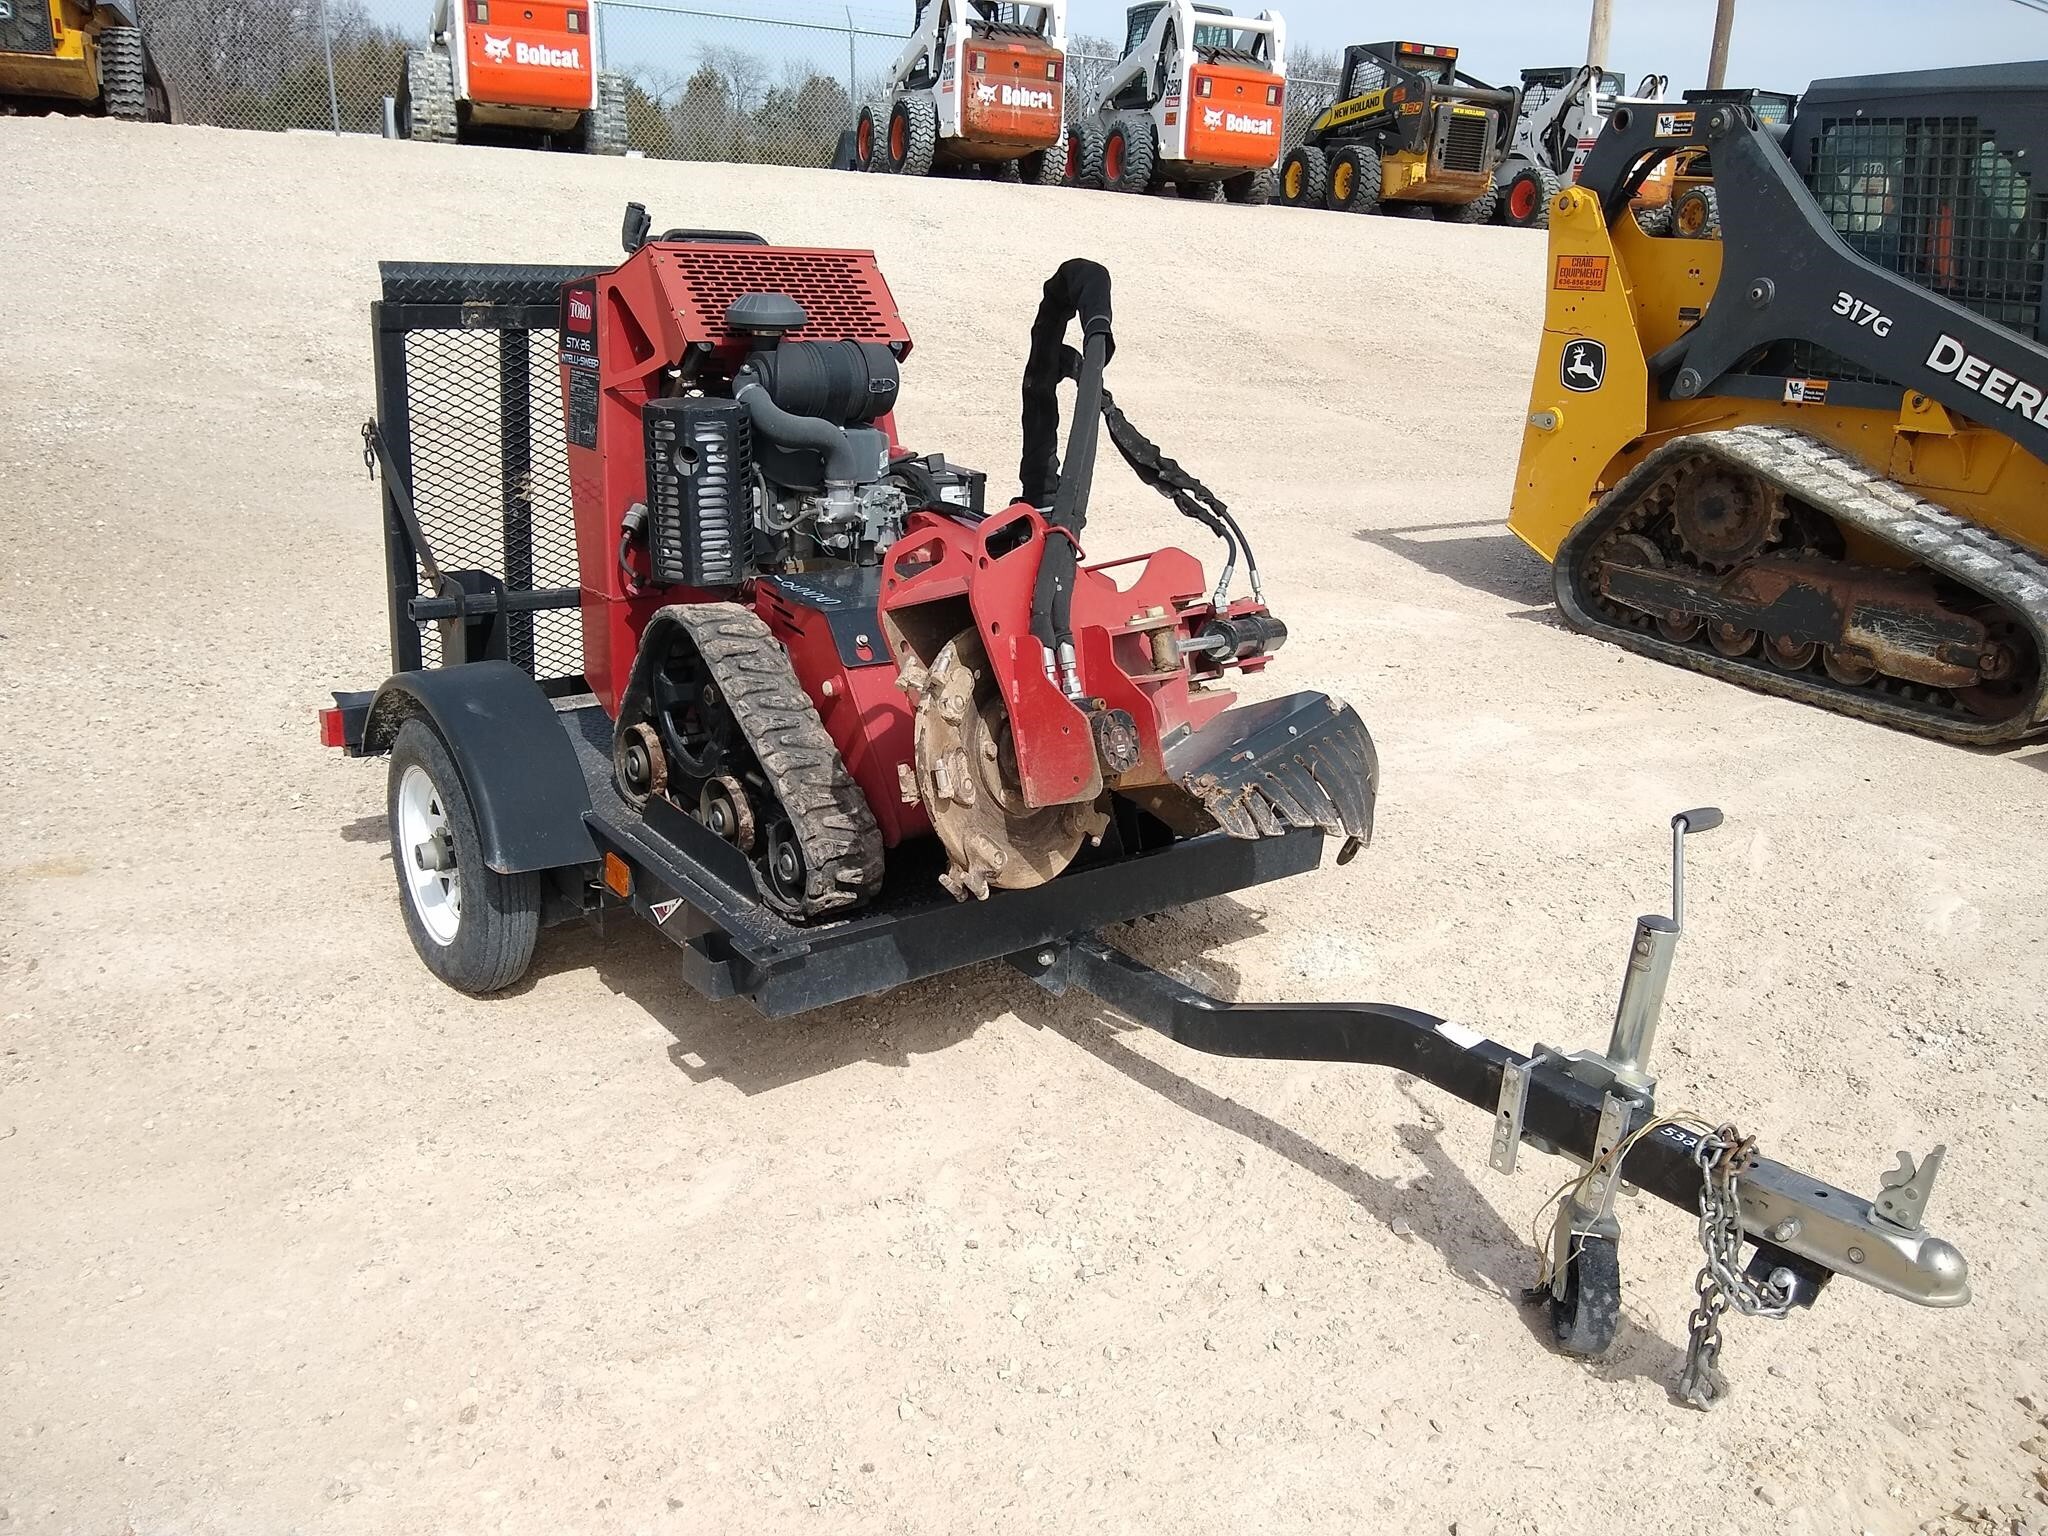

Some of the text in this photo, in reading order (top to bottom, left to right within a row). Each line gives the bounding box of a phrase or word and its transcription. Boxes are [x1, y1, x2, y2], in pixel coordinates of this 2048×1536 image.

[516, 42, 580, 69] Bobcat
[1002, 84, 1054, 109] Bobcat
[1334, 96, 1380, 119] NEW HOLLAND
[1226, 113, 1273, 135] Bobcat
[1560, 267, 1603, 278] EQUIPMENT!
[1572, 257, 1593, 267] CRAIG
[571, 298, 591, 319] TORO
[1832, 291, 1893, 337] 317G
[566, 336, 591, 351] STX-26
